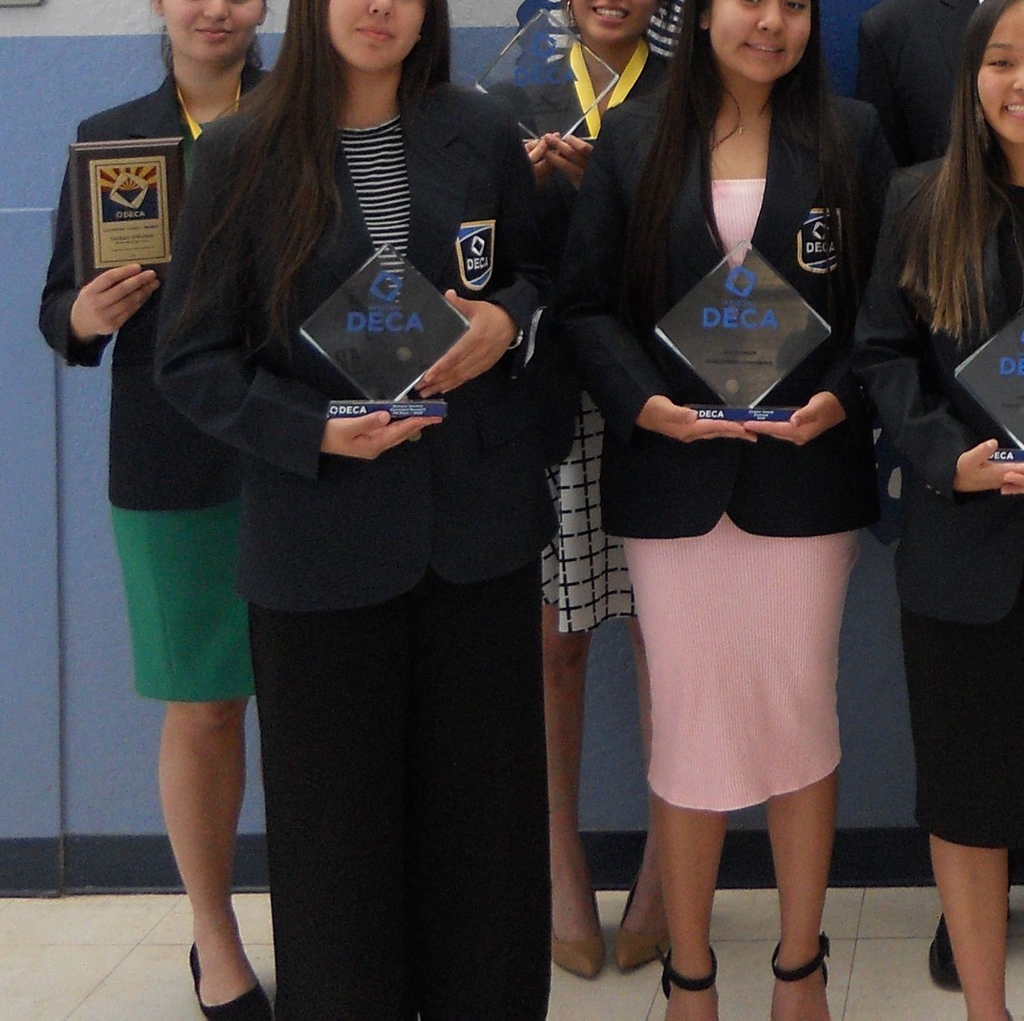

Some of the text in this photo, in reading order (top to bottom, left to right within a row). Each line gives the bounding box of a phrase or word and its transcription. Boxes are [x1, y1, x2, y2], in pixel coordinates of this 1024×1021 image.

[466, 257, 489, 271] DECA
[345, 311, 424, 332] DECA
[703, 307, 779, 329] DECA
[338, 405, 367, 415] DECA
[699, 410, 724, 418] DECA
